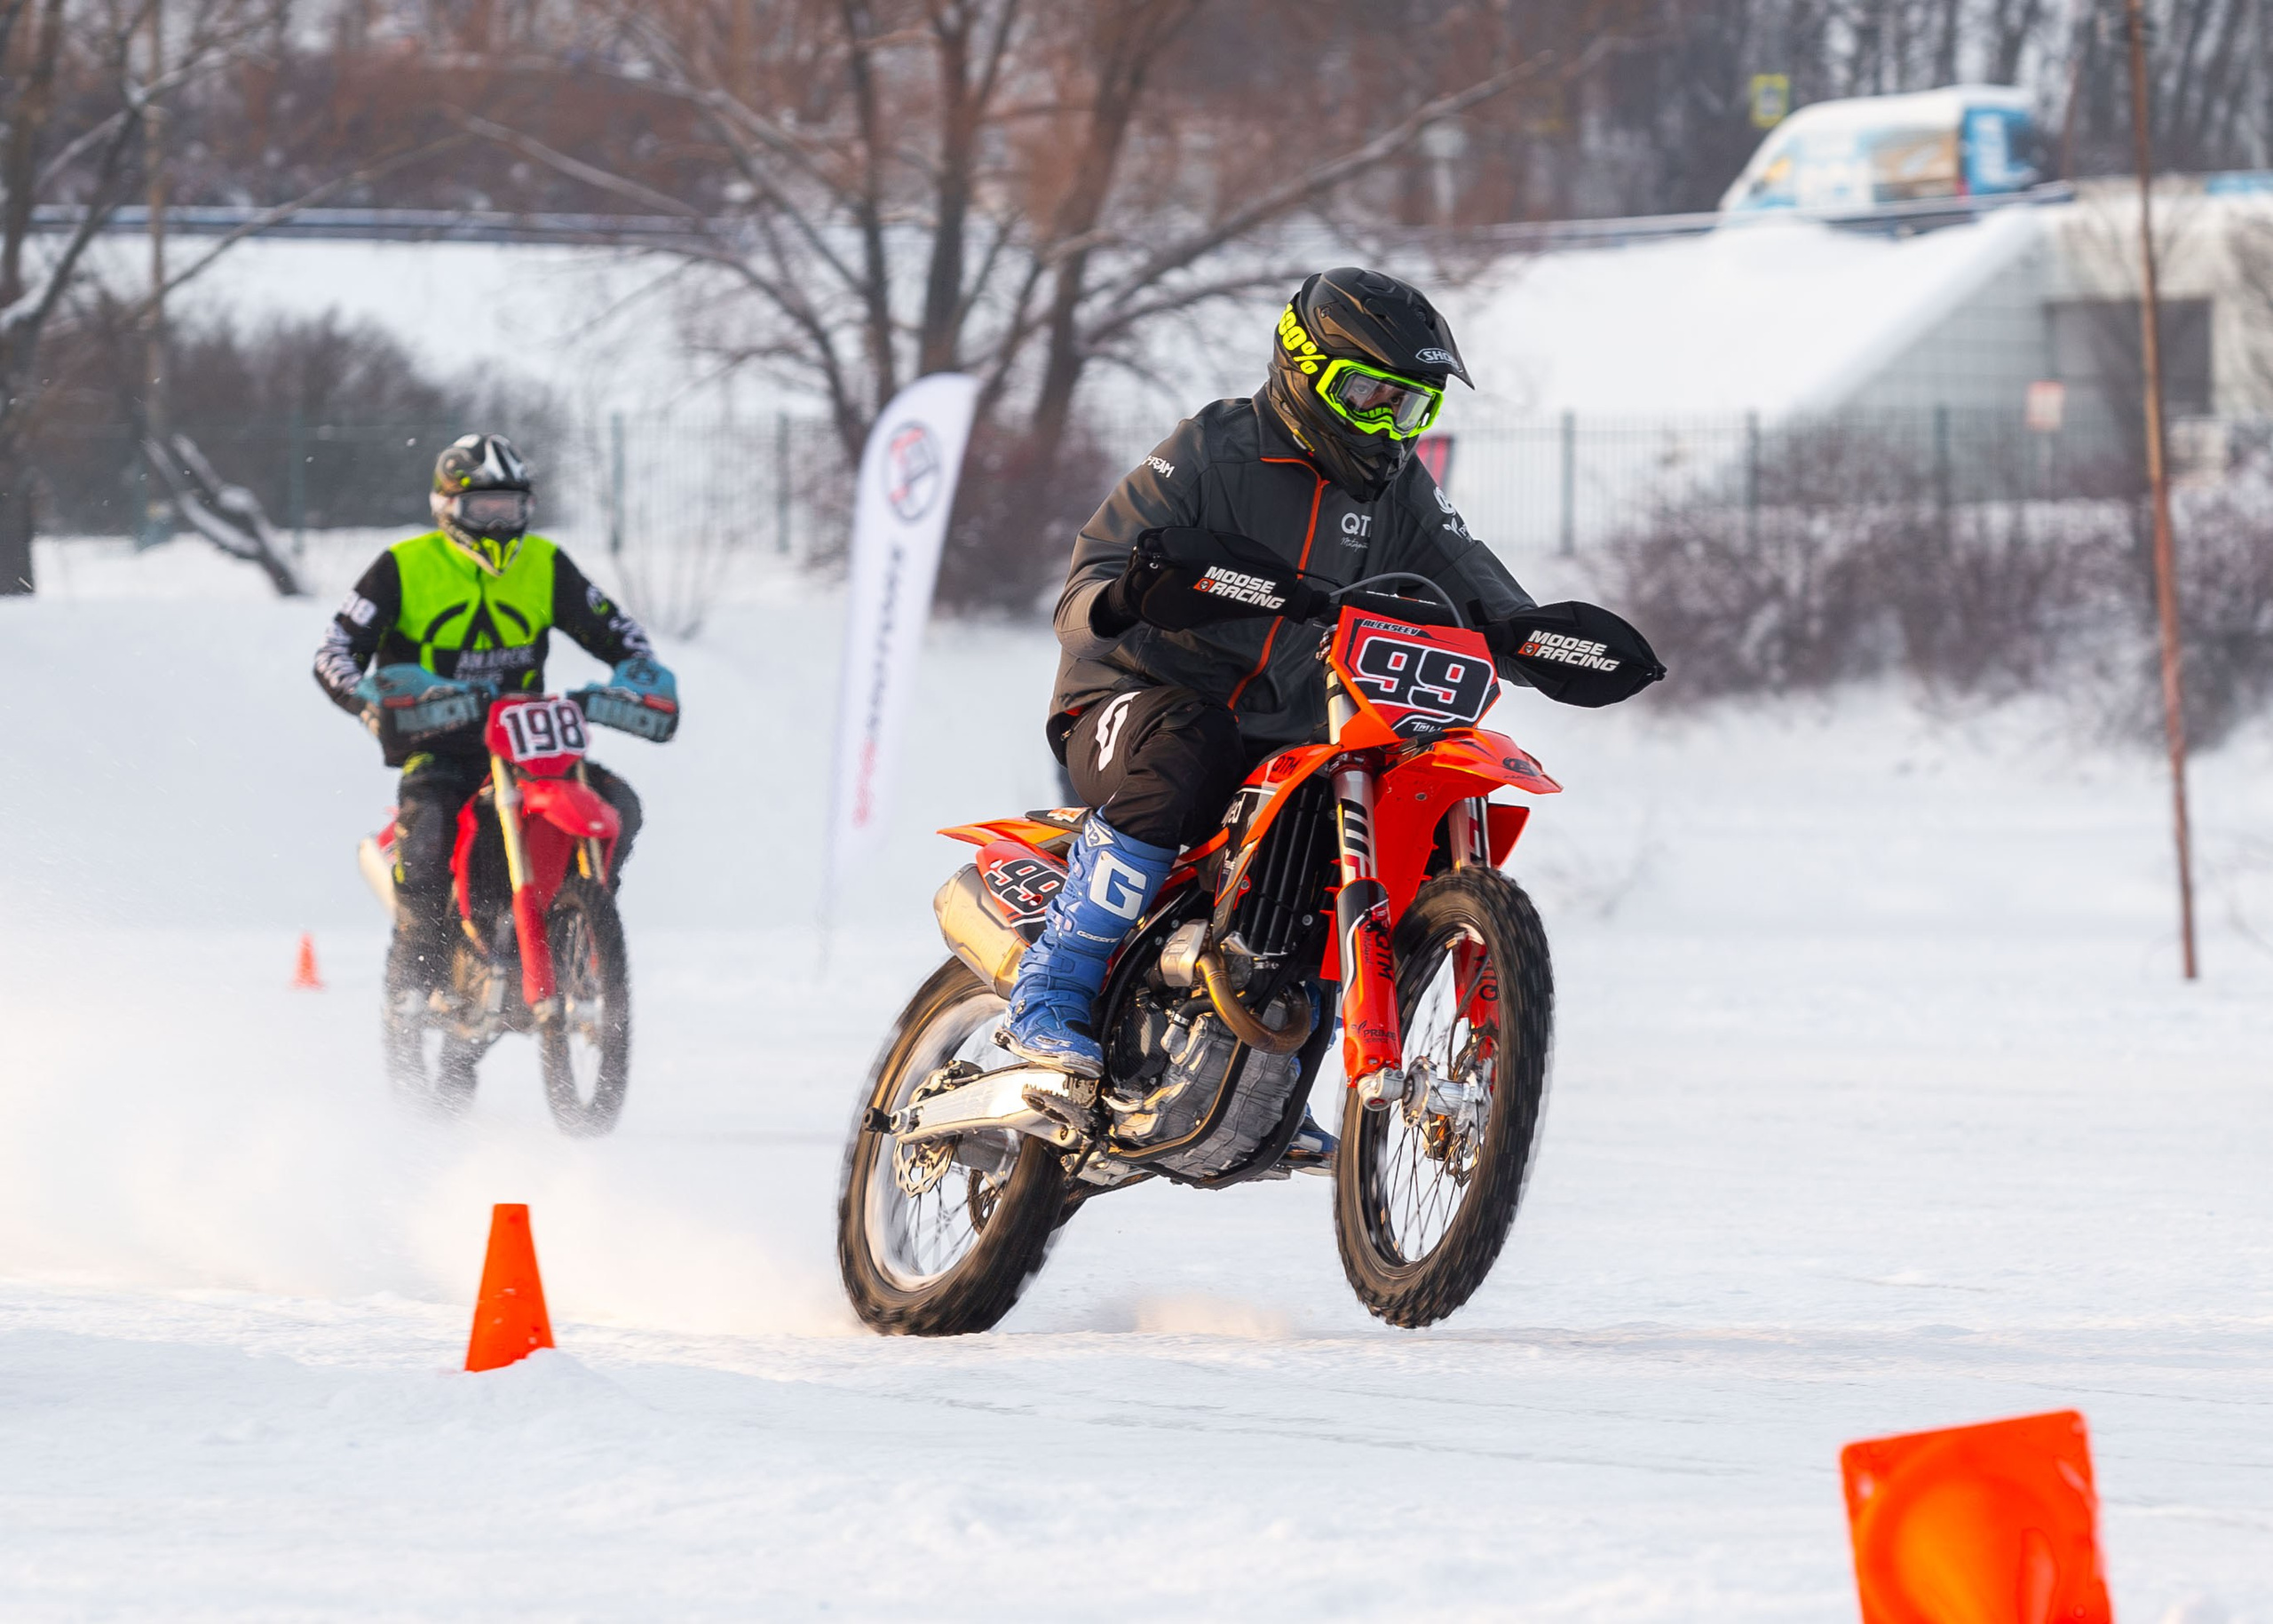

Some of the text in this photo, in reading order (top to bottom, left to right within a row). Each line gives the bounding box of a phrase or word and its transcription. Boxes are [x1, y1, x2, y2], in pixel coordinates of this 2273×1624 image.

[1342, 512, 1372, 537] QT
[1204, 566, 1277, 594] MOOSE
[1208, 582, 1286, 609] RACING
[1361, 619, 1421, 636] ALEKSEEV
[1528, 630, 1607, 655] MOOSE
[1534, 646, 1620, 671] RACING
[1351, 636, 1494, 722] 99
[503, 702, 588, 759] 198
[984, 859, 1067, 915] 99
[1089, 850, 1147, 921] G
